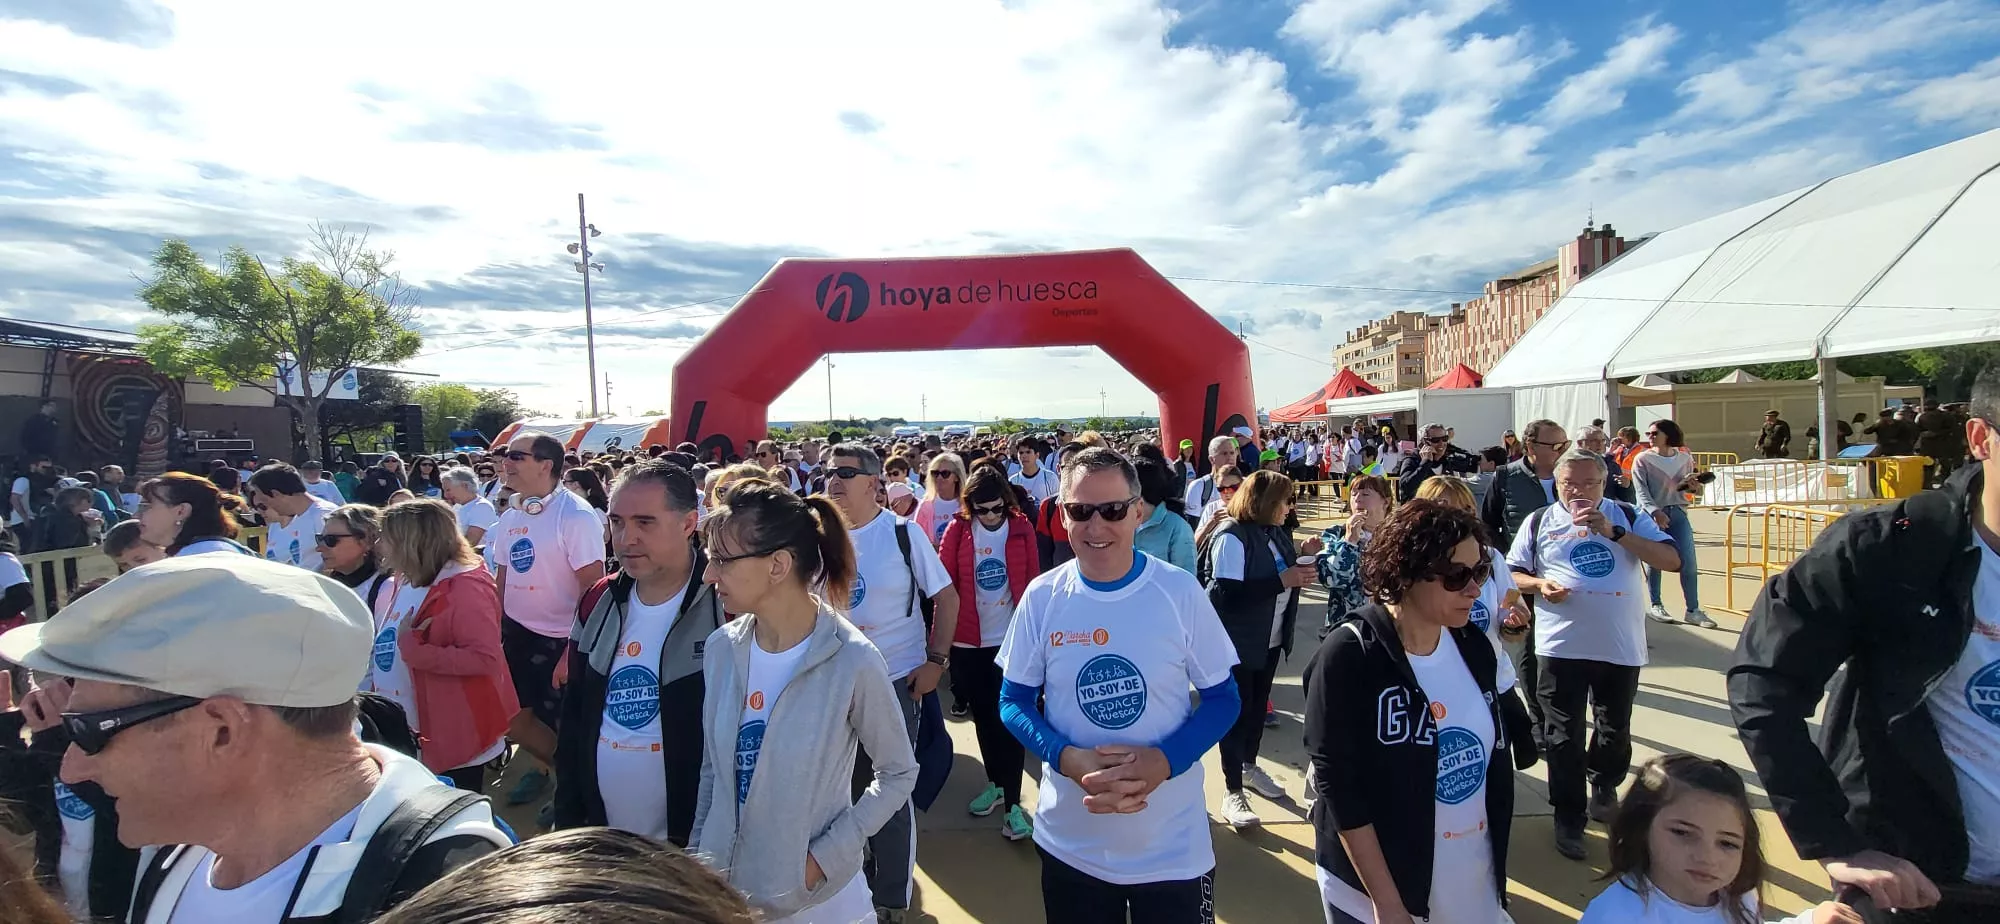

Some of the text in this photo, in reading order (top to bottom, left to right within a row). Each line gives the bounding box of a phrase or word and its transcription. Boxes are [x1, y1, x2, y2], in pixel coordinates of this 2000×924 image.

[879, 279, 1098, 311] hoya de huesca
[1052, 308, 1098, 318] Deportes
[1050, 631, 1064, 647] 12
[612, 700, 657, 715] ASPACE
[1091, 696, 1140, 714] ASPACE
